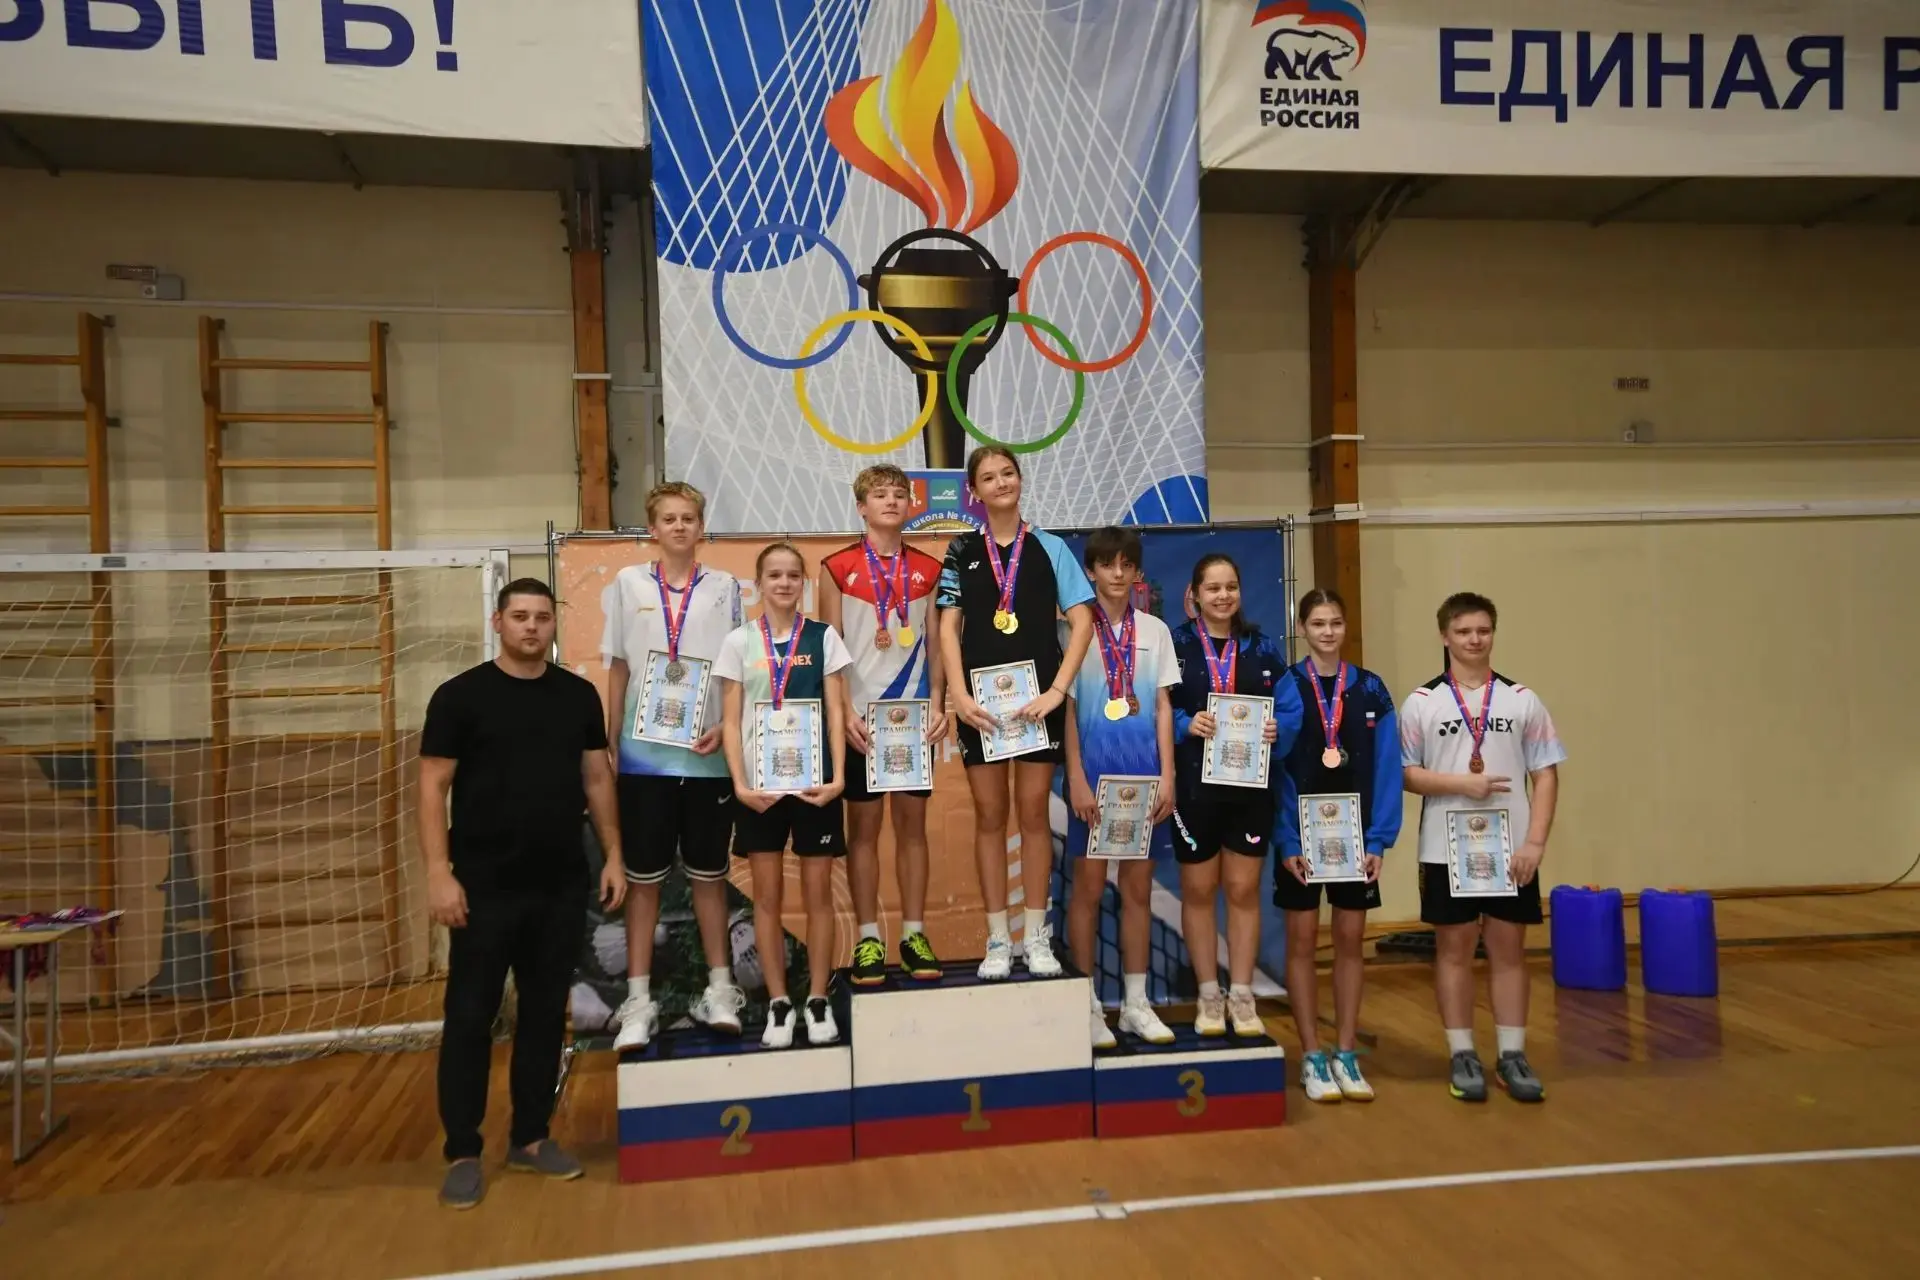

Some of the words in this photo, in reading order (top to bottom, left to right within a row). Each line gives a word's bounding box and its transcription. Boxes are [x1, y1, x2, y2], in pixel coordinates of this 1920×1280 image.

[1440, 28, 1844, 123] ЕДИНАЯ
[1260, 87, 1359, 106] ЕДИНАЯ
[1260, 109, 1360, 129] РОССИЯ
[911, 512, 944, 528] школа
[946, 510, 959, 520] №
[961, 514, 974, 525] 13
[776, 654, 812, 668] YNEX
[879, 725, 918, 734] ГРАМОТА
[1464, 717, 1515, 733] NEX
[1177, 1069, 1207, 1117] 3
[961, 1083, 991, 1132] 1
[719, 1105, 753, 1156] 2
